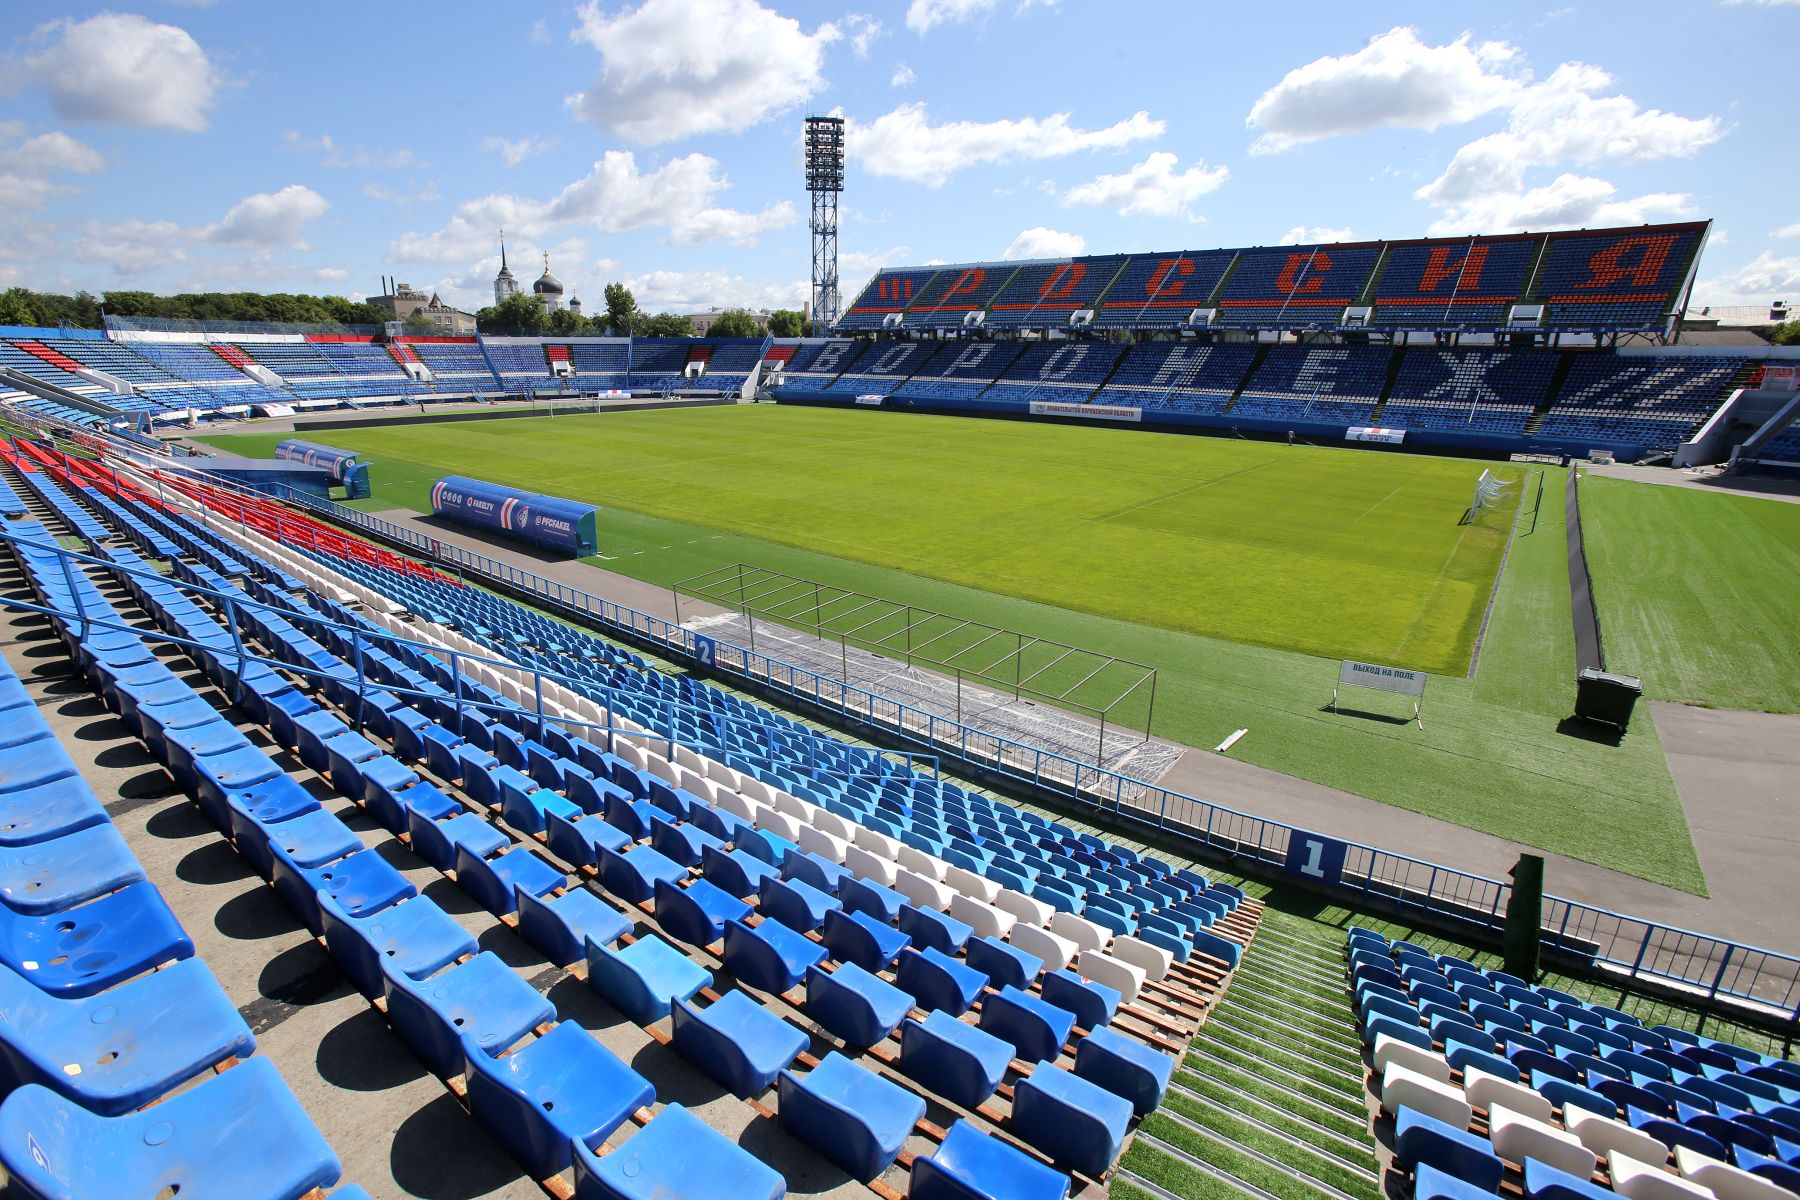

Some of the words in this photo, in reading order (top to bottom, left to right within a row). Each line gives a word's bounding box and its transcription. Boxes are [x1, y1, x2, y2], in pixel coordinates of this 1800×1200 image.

[808, 342, 1512, 402] ВОРОНЕЖ
[473, 499, 494, 511] FAKELTV
[699, 640, 711, 664] 2
[1353, 663, 1380, 676] ВЫХОД
[1381, 668, 1392, 677] НА
[1394, 670, 1416, 680] ПОЛЕ
[1300, 839, 1325, 878] 1
